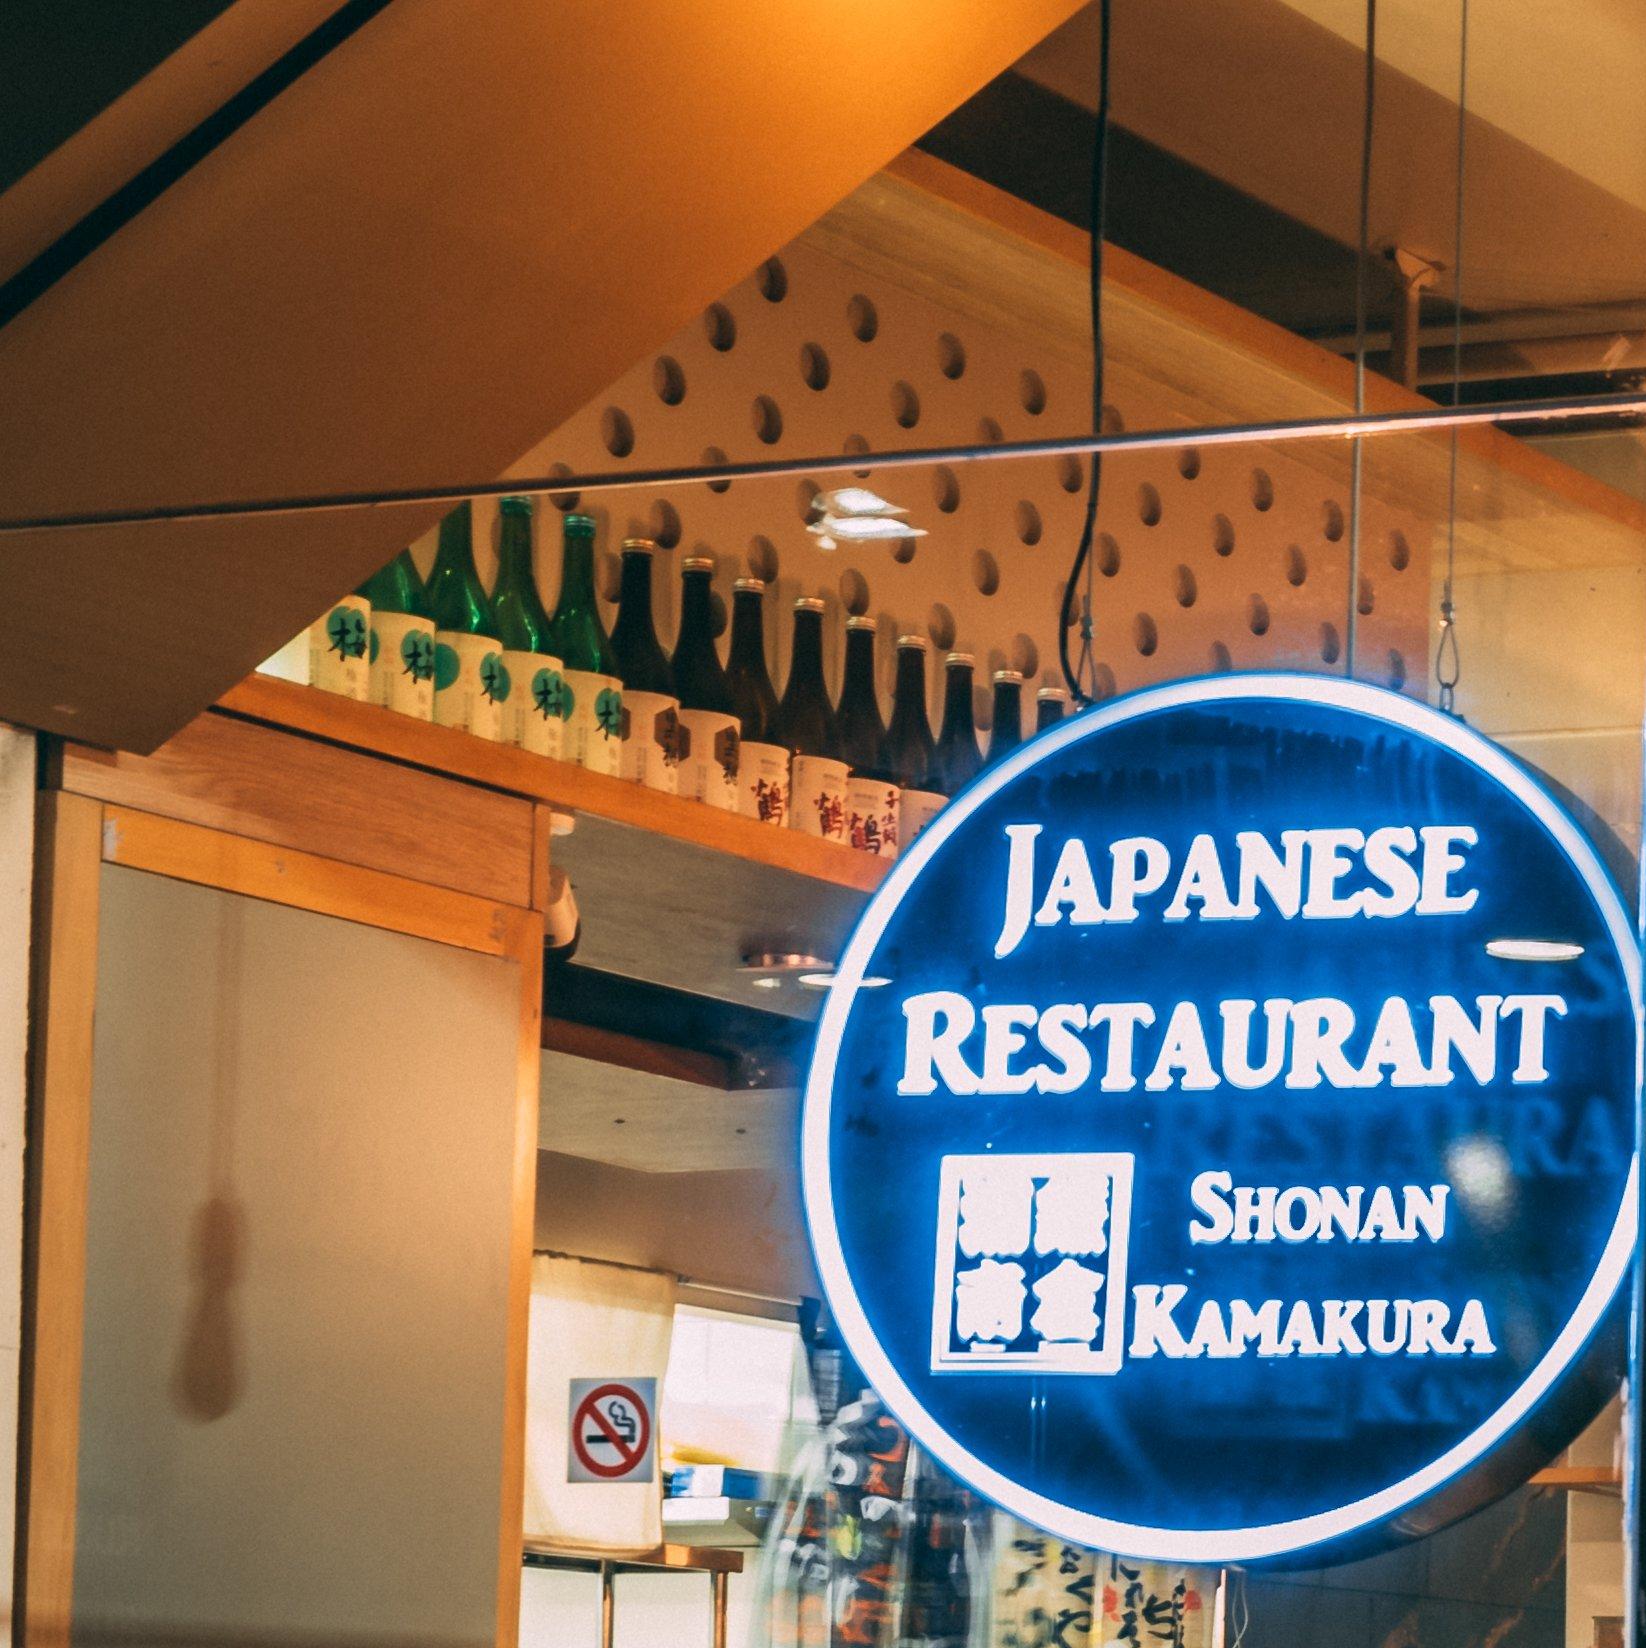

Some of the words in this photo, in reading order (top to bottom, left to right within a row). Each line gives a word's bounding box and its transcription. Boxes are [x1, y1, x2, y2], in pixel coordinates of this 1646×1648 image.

[993, 823, 1480, 959] JAPANESE
[896, 990, 1567, 1097] RESTAURANT
[1189, 1170, 1450, 1244] SHONAN
[1128, 1284, 1497, 1359] KAMAKURA
